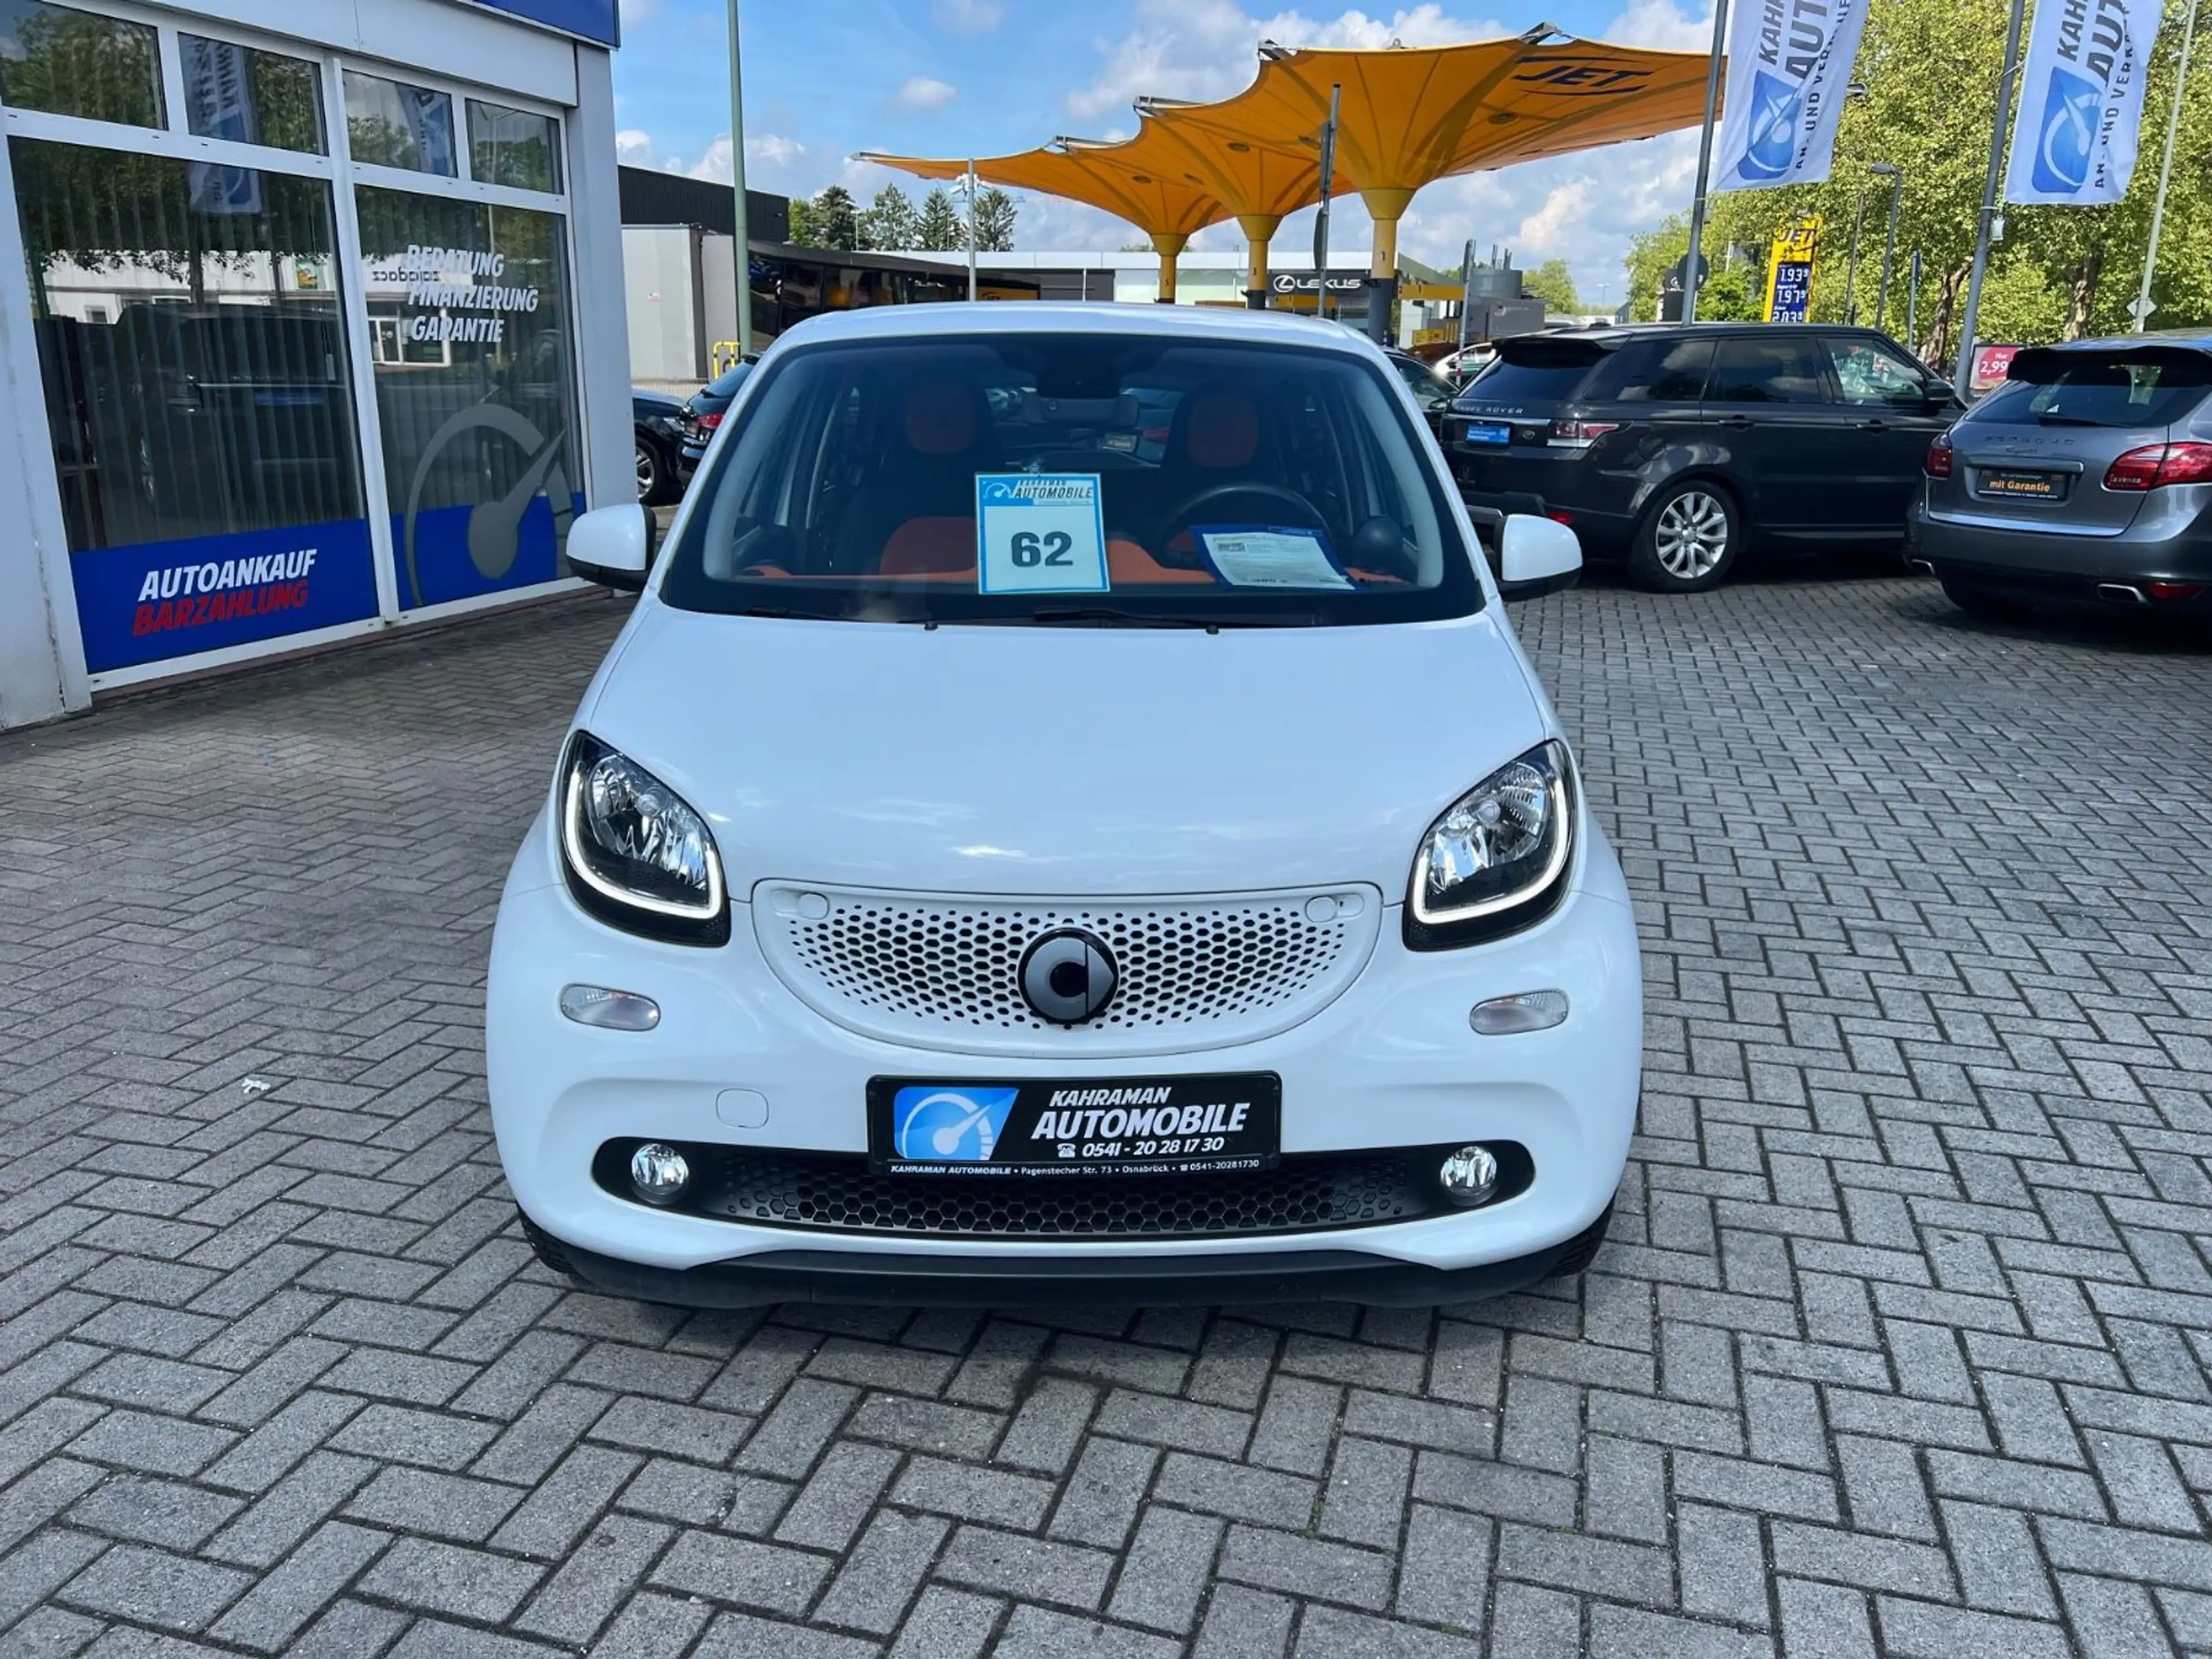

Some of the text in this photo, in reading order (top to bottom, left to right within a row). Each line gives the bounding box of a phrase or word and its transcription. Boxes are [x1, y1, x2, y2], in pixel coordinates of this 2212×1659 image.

[2057, 0, 2088, 62] KAH
[1512, 65, 1655, 87] JET
[1806, 92, 1820, 131] UND
[2101, 107, 2119, 145] UND
[1778, 227, 1818, 243] JET
[406, 244, 505, 278] BERATUNG
[1297, 279, 1361, 289] LEXUS
[407, 283, 540, 312] FINANZIERUNG
[411, 316, 505, 343] GARANTIE
[1980, 361, 2008, 376] 2,99
[1486, 406, 1524, 415] ROVER
[1014, 487, 1094, 499] AUTOMOBILE
[1989, 480, 2051, 493] mit Garantie
[1011, 531, 1074, 568] 62
[138, 548, 318, 603] AUTOANKAUF
[132, 579, 309, 637] BARZAHLUNG
[1048, 1086, 1172, 1107] KAHRAMAN
[1030, 1102, 1251, 1140] AUTOMOBILE
[1082, 1141, 1123, 1157] 0541
[1133, 1141, 1157, 1156] 20
[1158, 1139, 1181, 1154] 28
[1183, 1138, 1200, 1153] 17
[1201, 1137, 1225, 1152] 30
[890, 1165, 946, 1173] KAHRAMAN
[948, 1166, 1012, 1175] AUTOMOBILE
[1021, 1166, 1081, 1176] Pagenstecher
[1101, 1166, 1112, 1174] 73
[1122, 1165, 1169, 1173] Osnabrück
[1190, 1159, 1260, 1172] 0541-20281730
